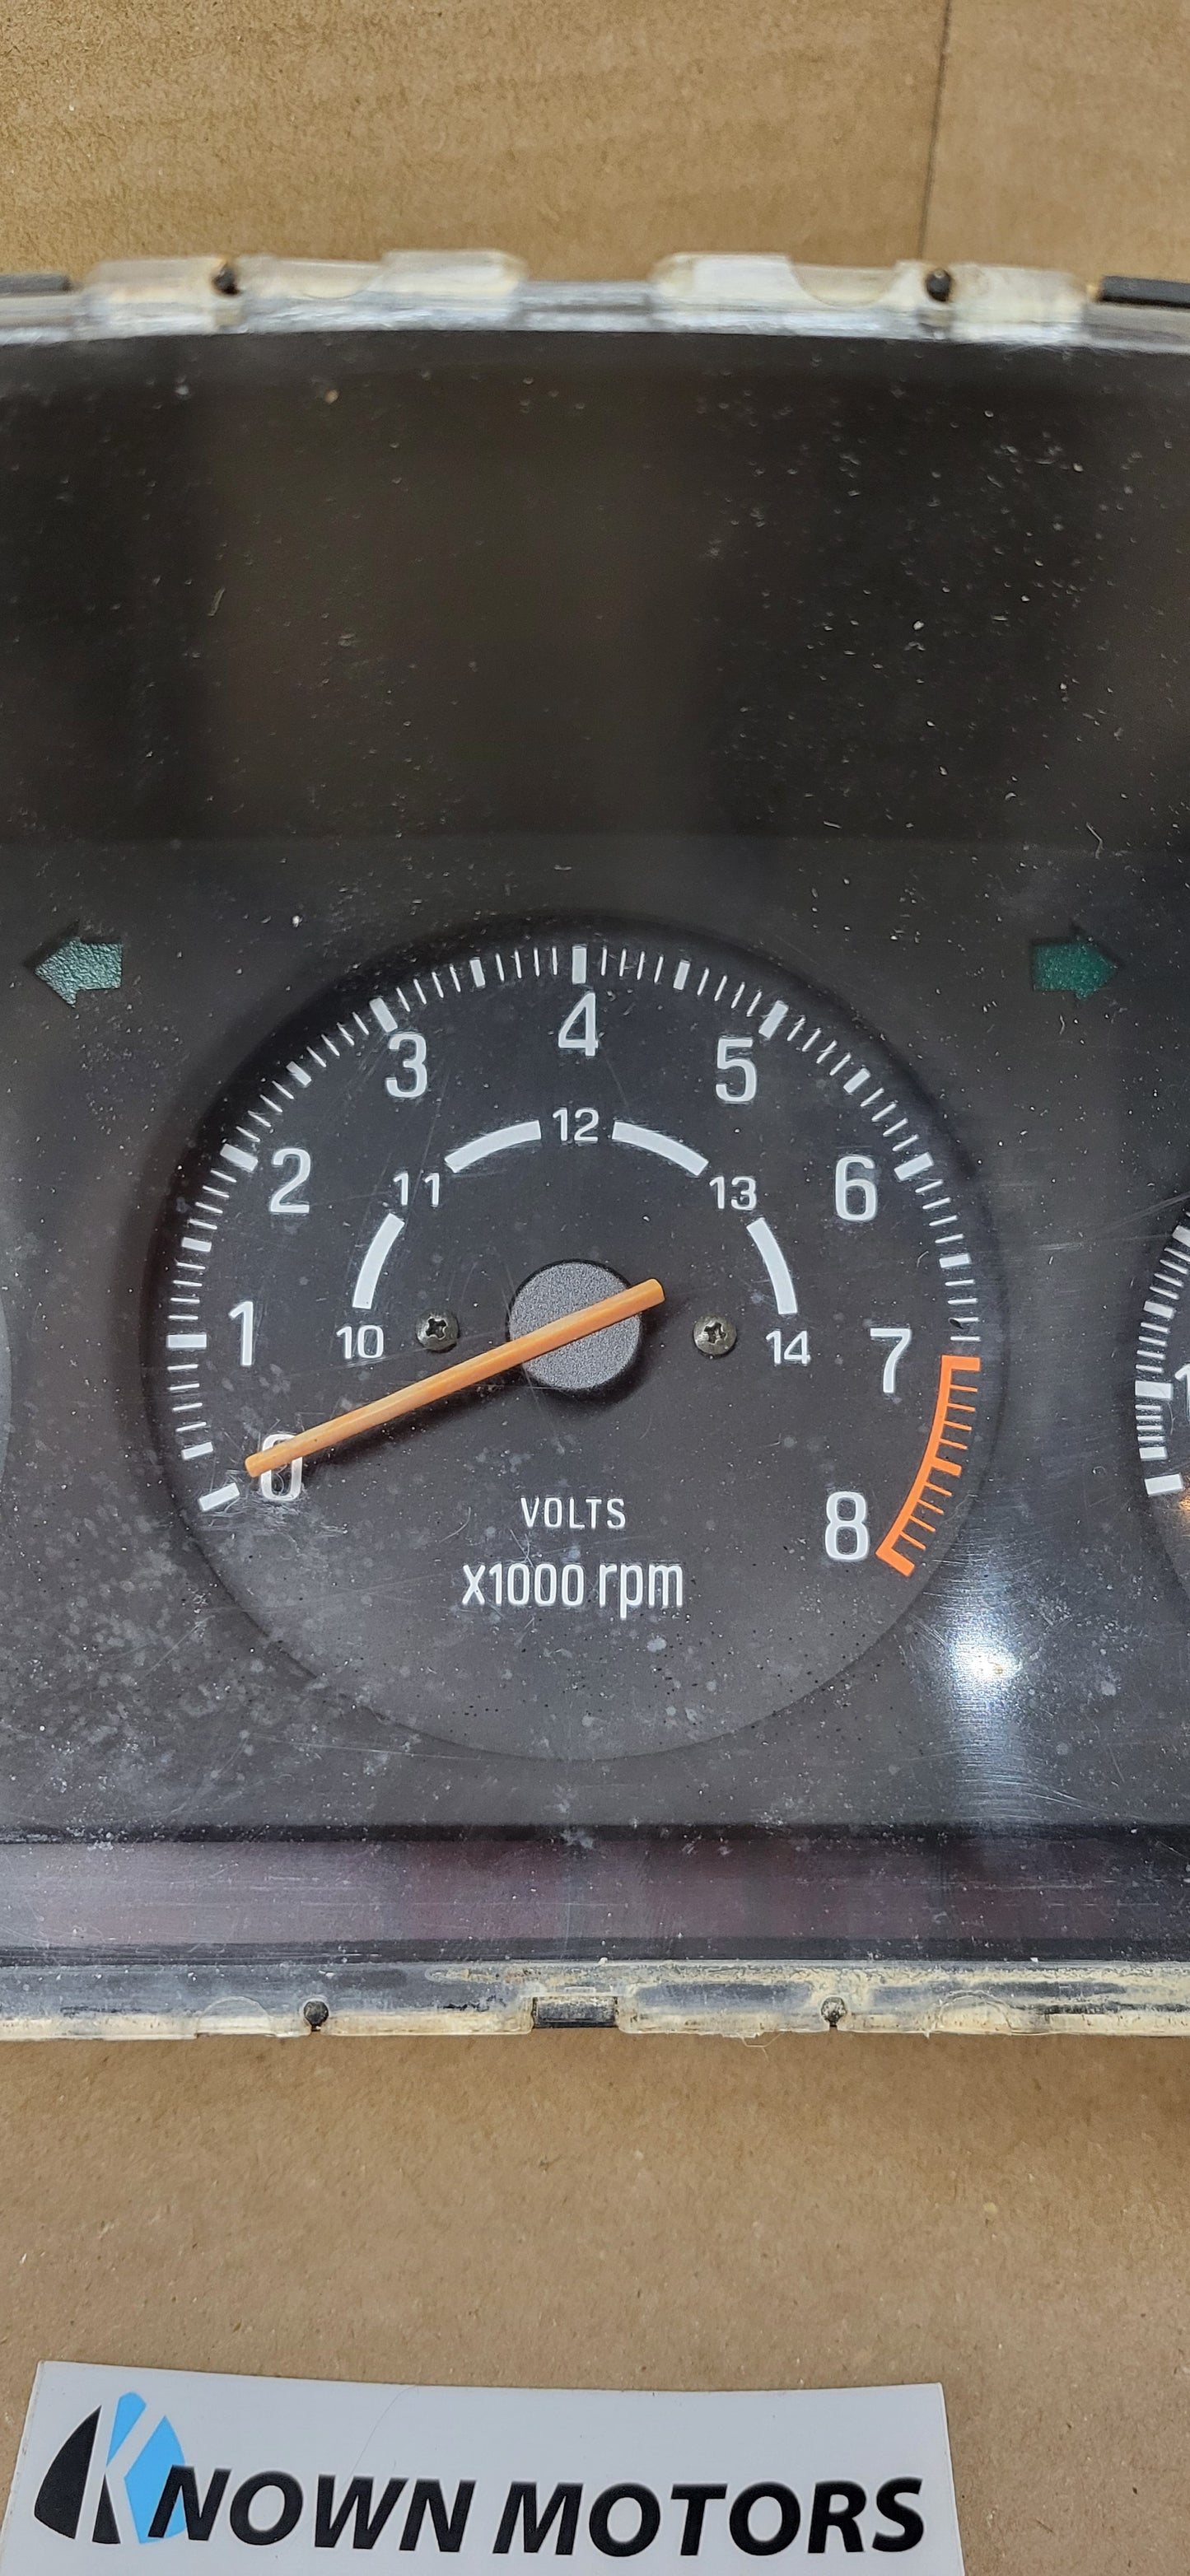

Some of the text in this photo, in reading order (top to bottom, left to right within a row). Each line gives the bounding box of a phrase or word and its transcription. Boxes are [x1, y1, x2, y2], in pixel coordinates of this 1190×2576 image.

[558, 991, 599, 1057] 4
[385, 1033, 429, 1099] 3
[715, 1037, 758, 1104] 5
[552, 1107, 600, 1142] 12
[268, 1146, 311, 1214] 2
[393, 1171, 440, 1208] 11
[709, 1175, 758, 1211] 13
[834, 1154, 878, 1222] 6
[227, 1300, 254, 1368] 1
[335, 1324, 385, 1360] 10
[765, 1330, 811, 1367] 14
[870, 1328, 912, 1394] 7
[260, 1433, 304, 1501] 0
[520, 1496, 626, 1531] VOLTS
[824, 1490, 870, 1561] 8
[461, 1561, 684, 1622] x1000 rpm
[33, 2392, 924, 2556] KNOWN MOTORS
